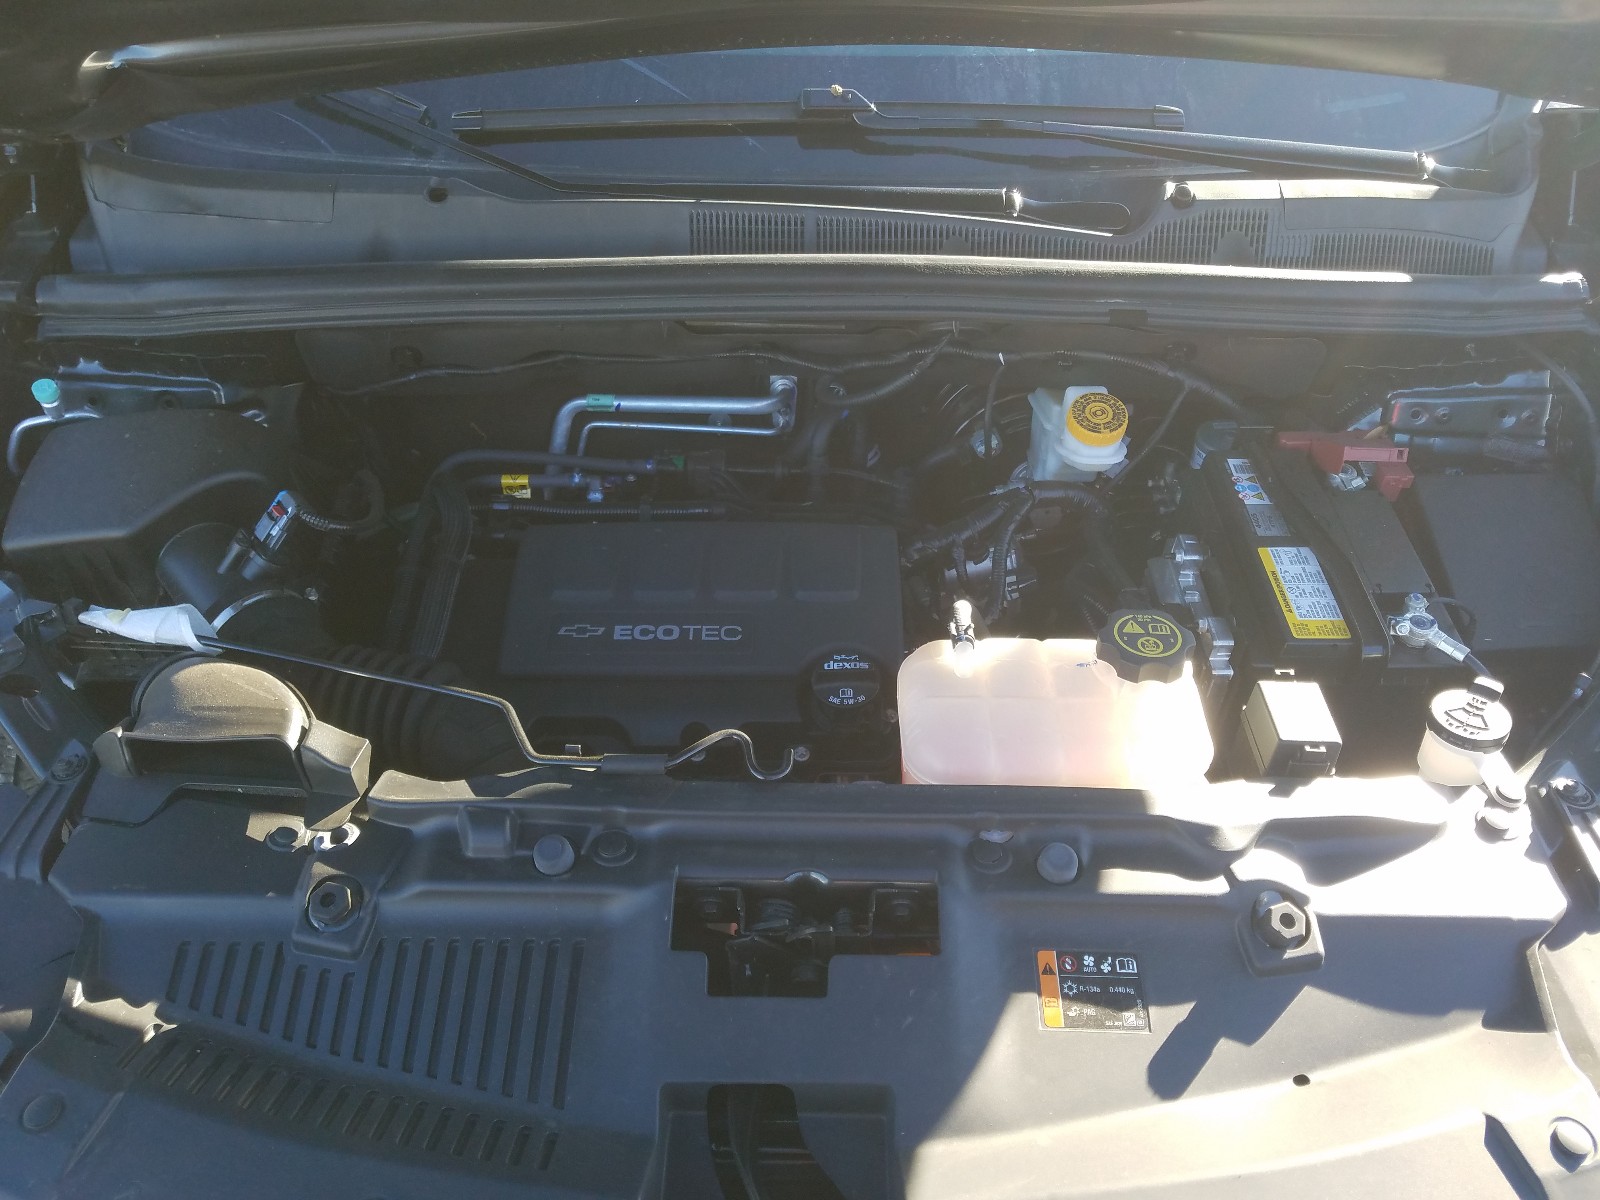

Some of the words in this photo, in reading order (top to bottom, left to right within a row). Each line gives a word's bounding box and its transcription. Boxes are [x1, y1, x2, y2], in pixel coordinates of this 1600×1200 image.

[613, 625, 743, 641] ECOTEC
[824, 660, 869, 670] dexos
[828, 695, 841, 705] SAE
[843, 694, 866, 705] 5W-30
